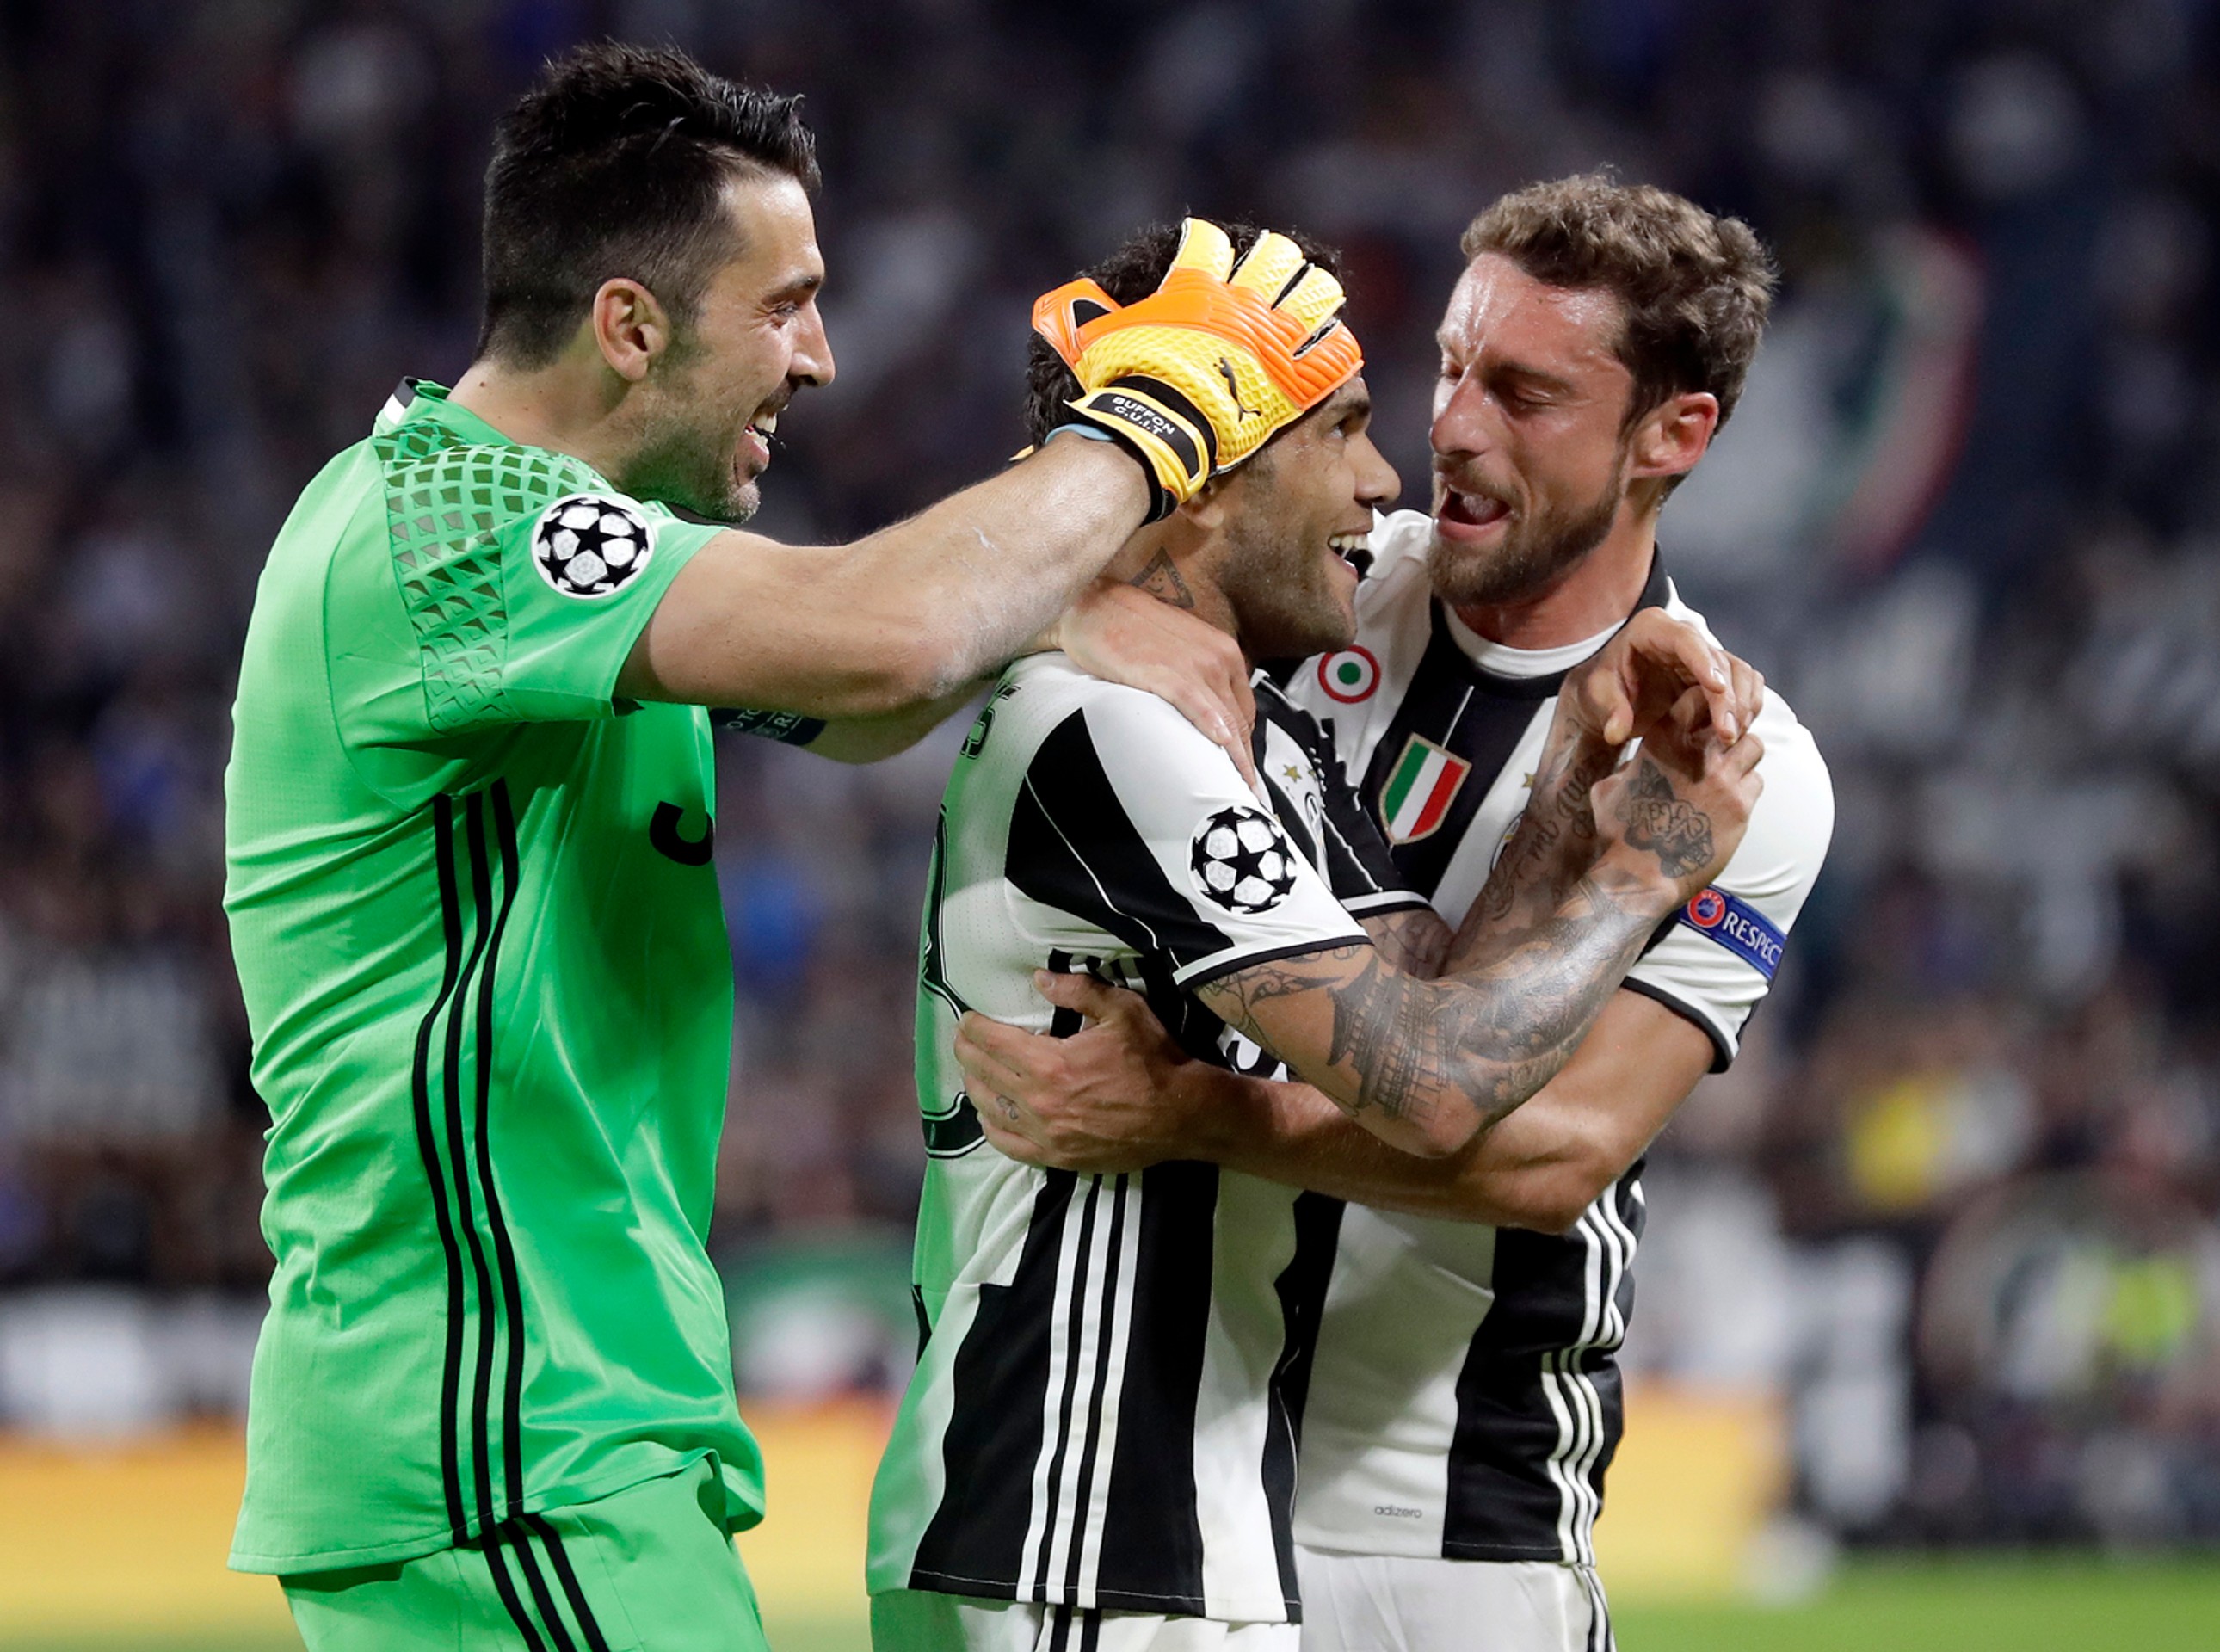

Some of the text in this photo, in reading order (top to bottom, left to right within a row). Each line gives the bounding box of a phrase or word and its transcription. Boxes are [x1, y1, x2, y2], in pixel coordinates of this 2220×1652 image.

[1113, 397, 1175, 435] BUFFON
[1723, 912, 1783, 965] RESPEC
[1375, 1505, 1422, 1519] adizero
